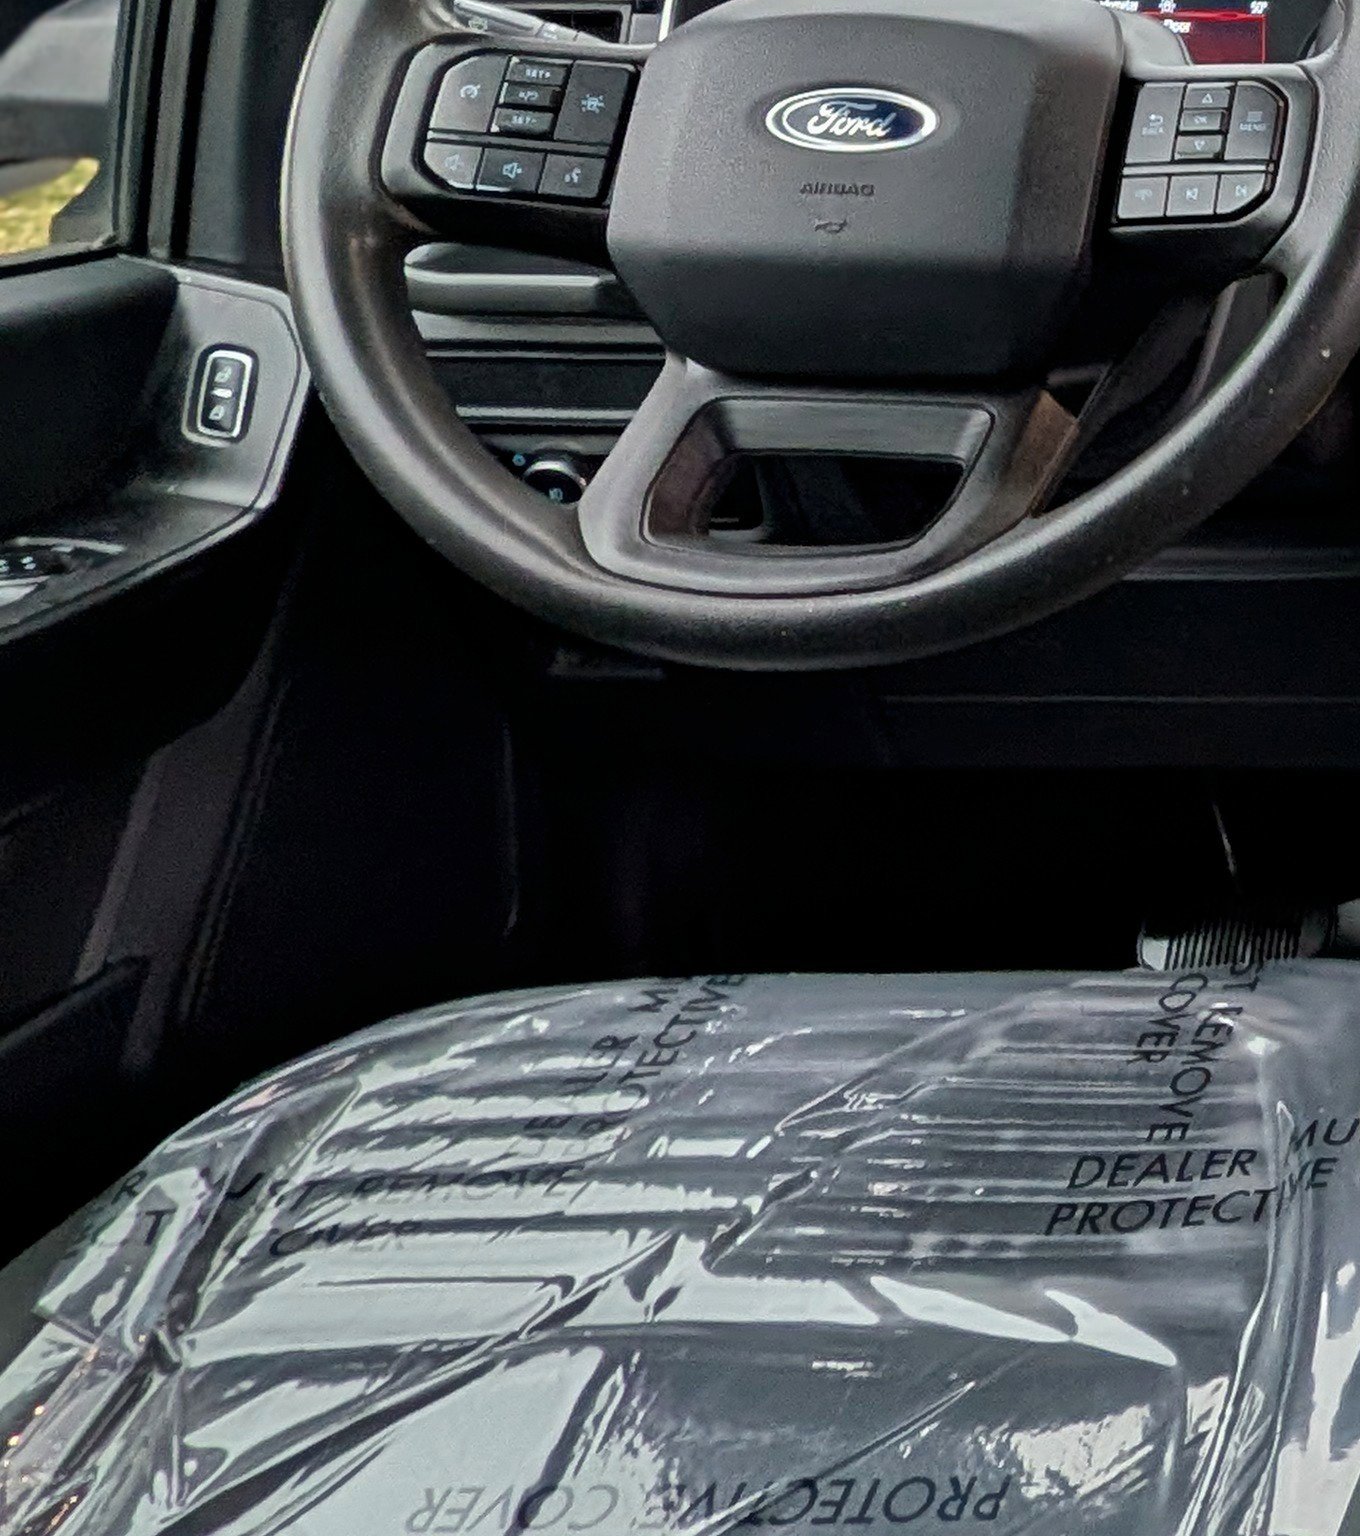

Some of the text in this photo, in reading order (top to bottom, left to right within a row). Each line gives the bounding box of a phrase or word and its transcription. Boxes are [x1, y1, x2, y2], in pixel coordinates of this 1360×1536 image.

[806, 100, 898, 138] Ford
[799, 181, 876, 197] AIRBAG
[1125, 972, 1209, 1066] COVER
[1145, 1006, 1244, 1143] REMOVE
[1066, 1147, 1259, 1190] DEALER
[402, 1482, 619, 1535] COVER
